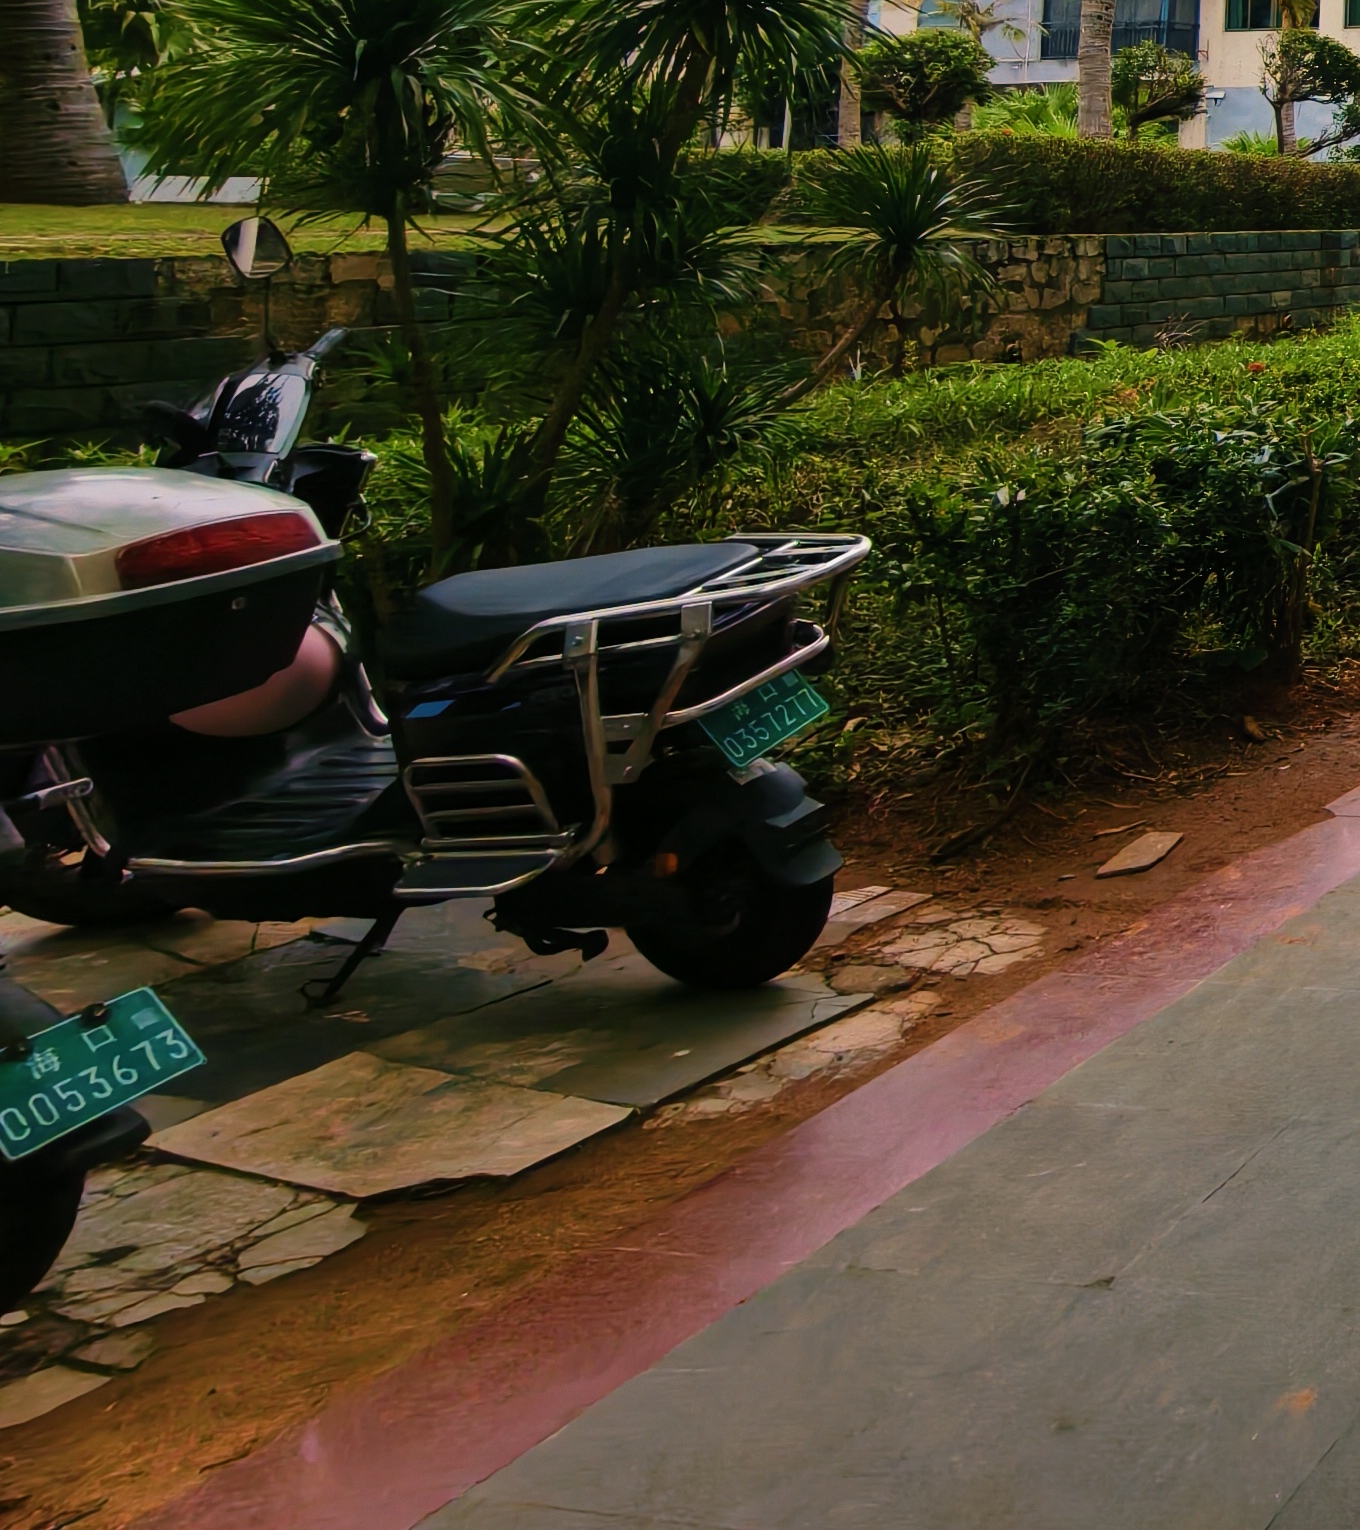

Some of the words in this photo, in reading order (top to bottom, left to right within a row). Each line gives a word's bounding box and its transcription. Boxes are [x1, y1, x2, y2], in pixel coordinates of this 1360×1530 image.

[723, 688, 818, 757] 0357277
[0, 1028, 189, 1140] 0053673
[27, 1025, 117, 1080] 海口
